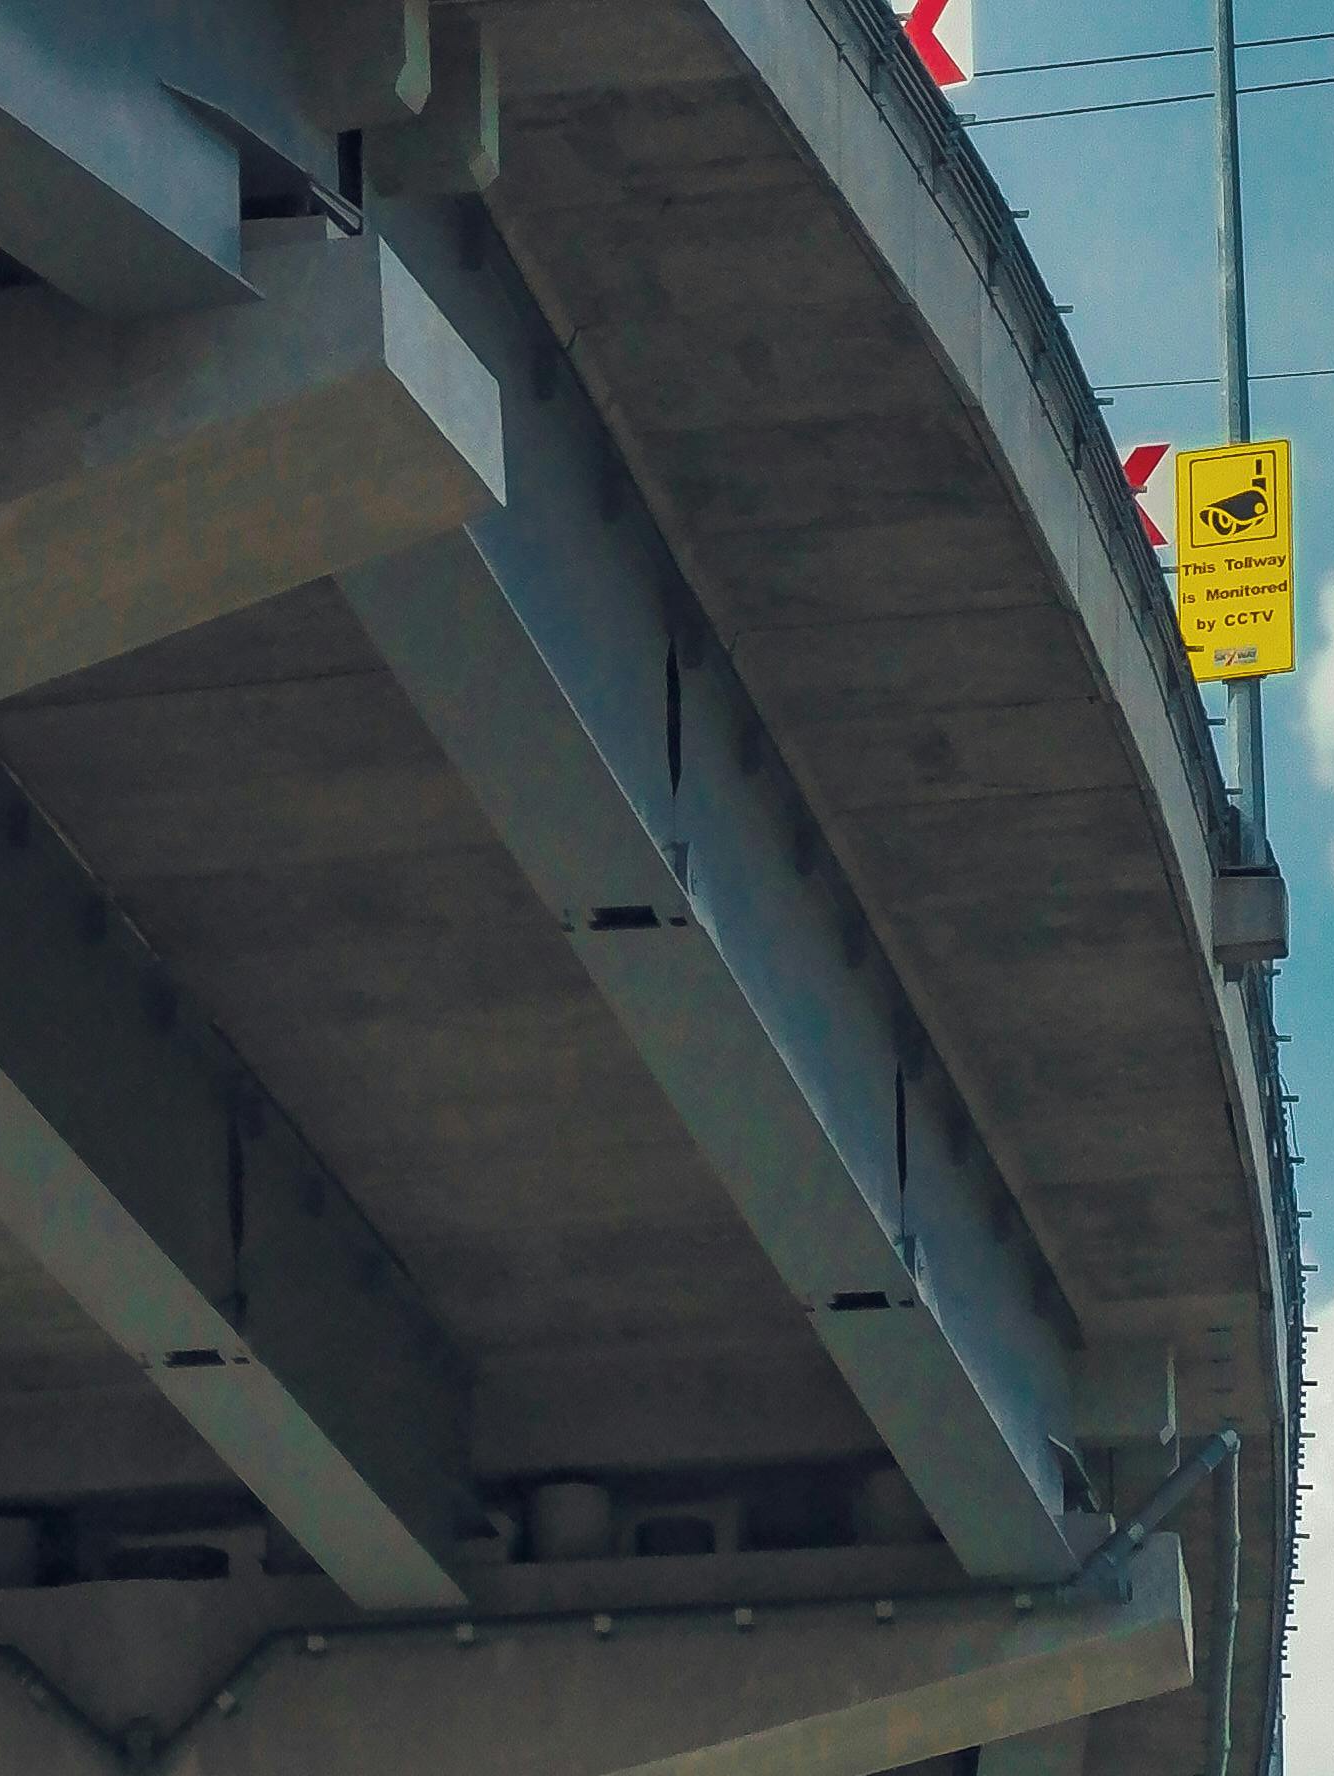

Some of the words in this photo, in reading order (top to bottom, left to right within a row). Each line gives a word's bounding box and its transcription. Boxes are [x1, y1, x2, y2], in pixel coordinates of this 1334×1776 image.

[1182, 562, 1216, 577] This
[1224, 555, 1287, 572] Tollway
[1206, 579, 1288, 602] Monitored
[1196, 618, 1216, 632] by
[1224, 609, 1274, 627] CCTV
